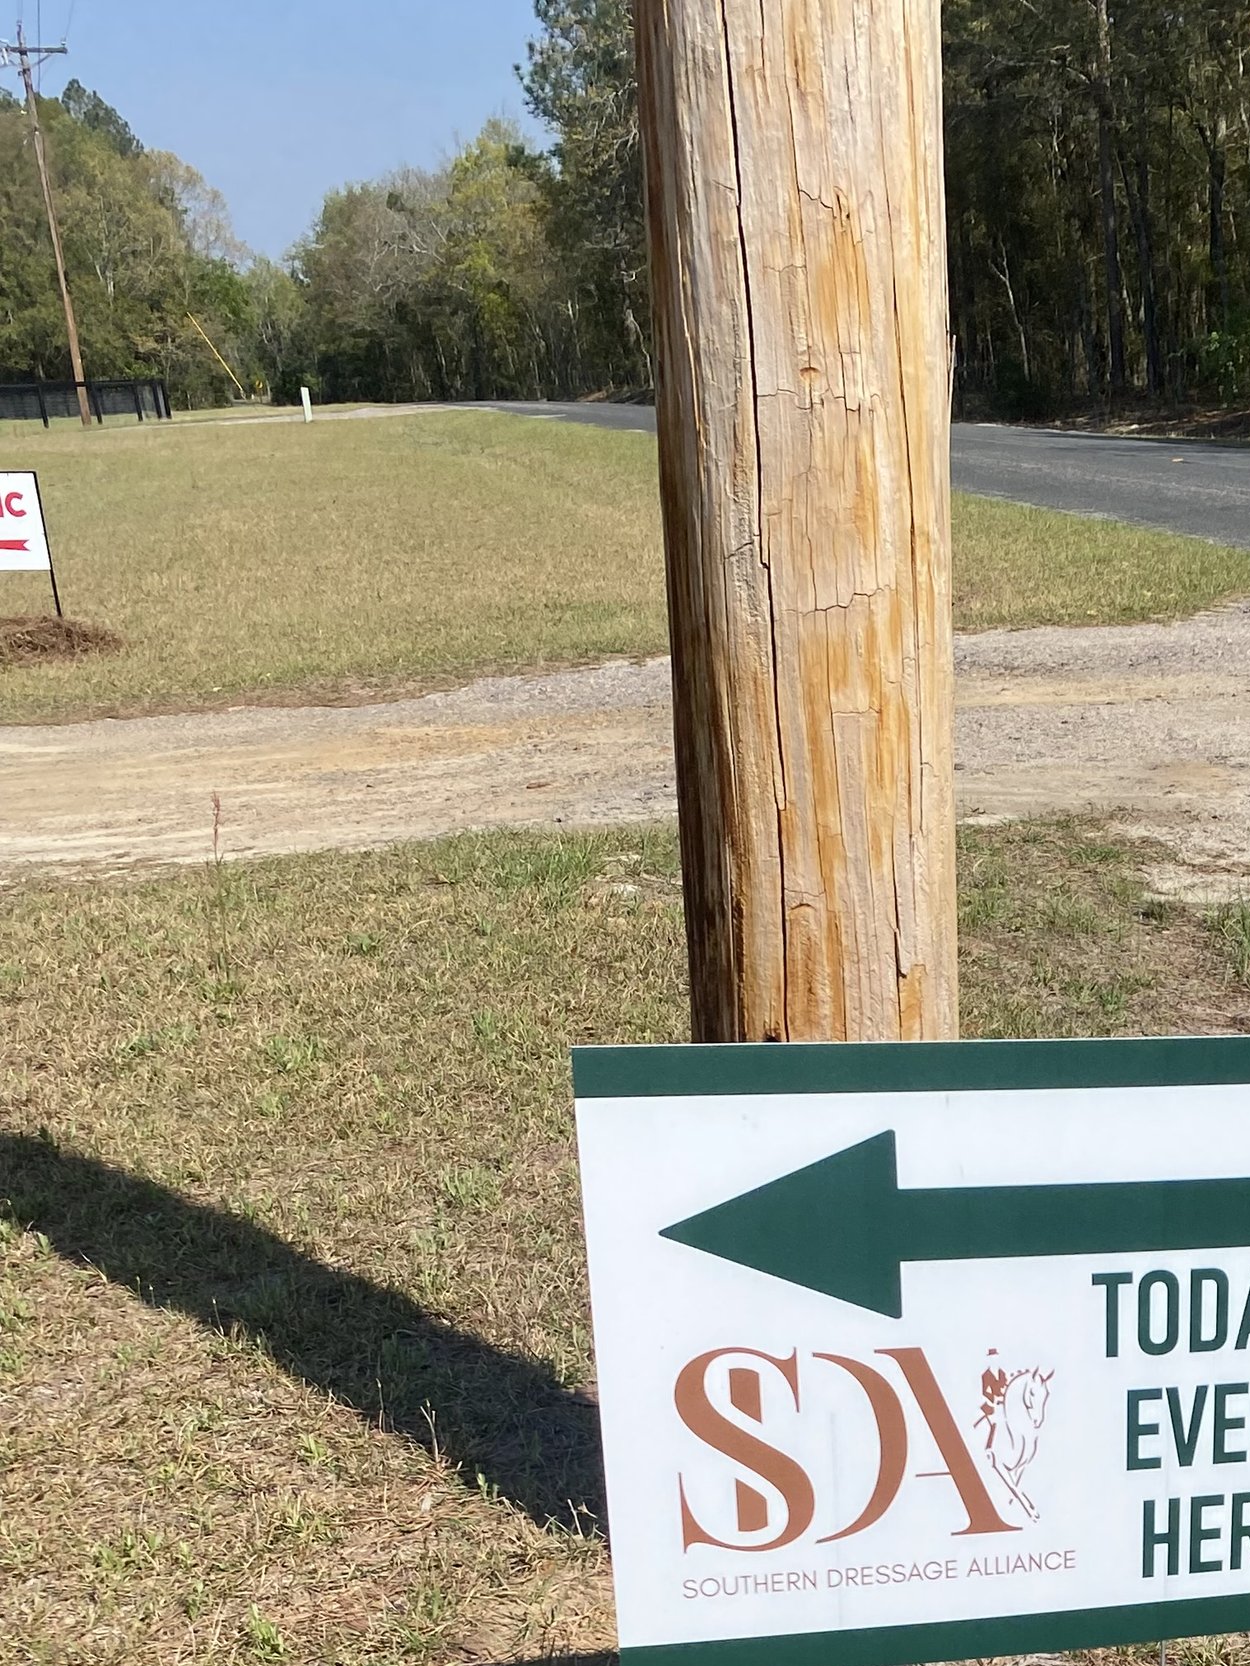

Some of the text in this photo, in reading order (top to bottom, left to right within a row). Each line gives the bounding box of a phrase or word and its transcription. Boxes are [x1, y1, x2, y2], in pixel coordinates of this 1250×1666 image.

[673, 1346, 1024, 1555] SDA
[682, 1549, 1077, 1599] SOUTHERN DRESSAGE ALLIANCE
